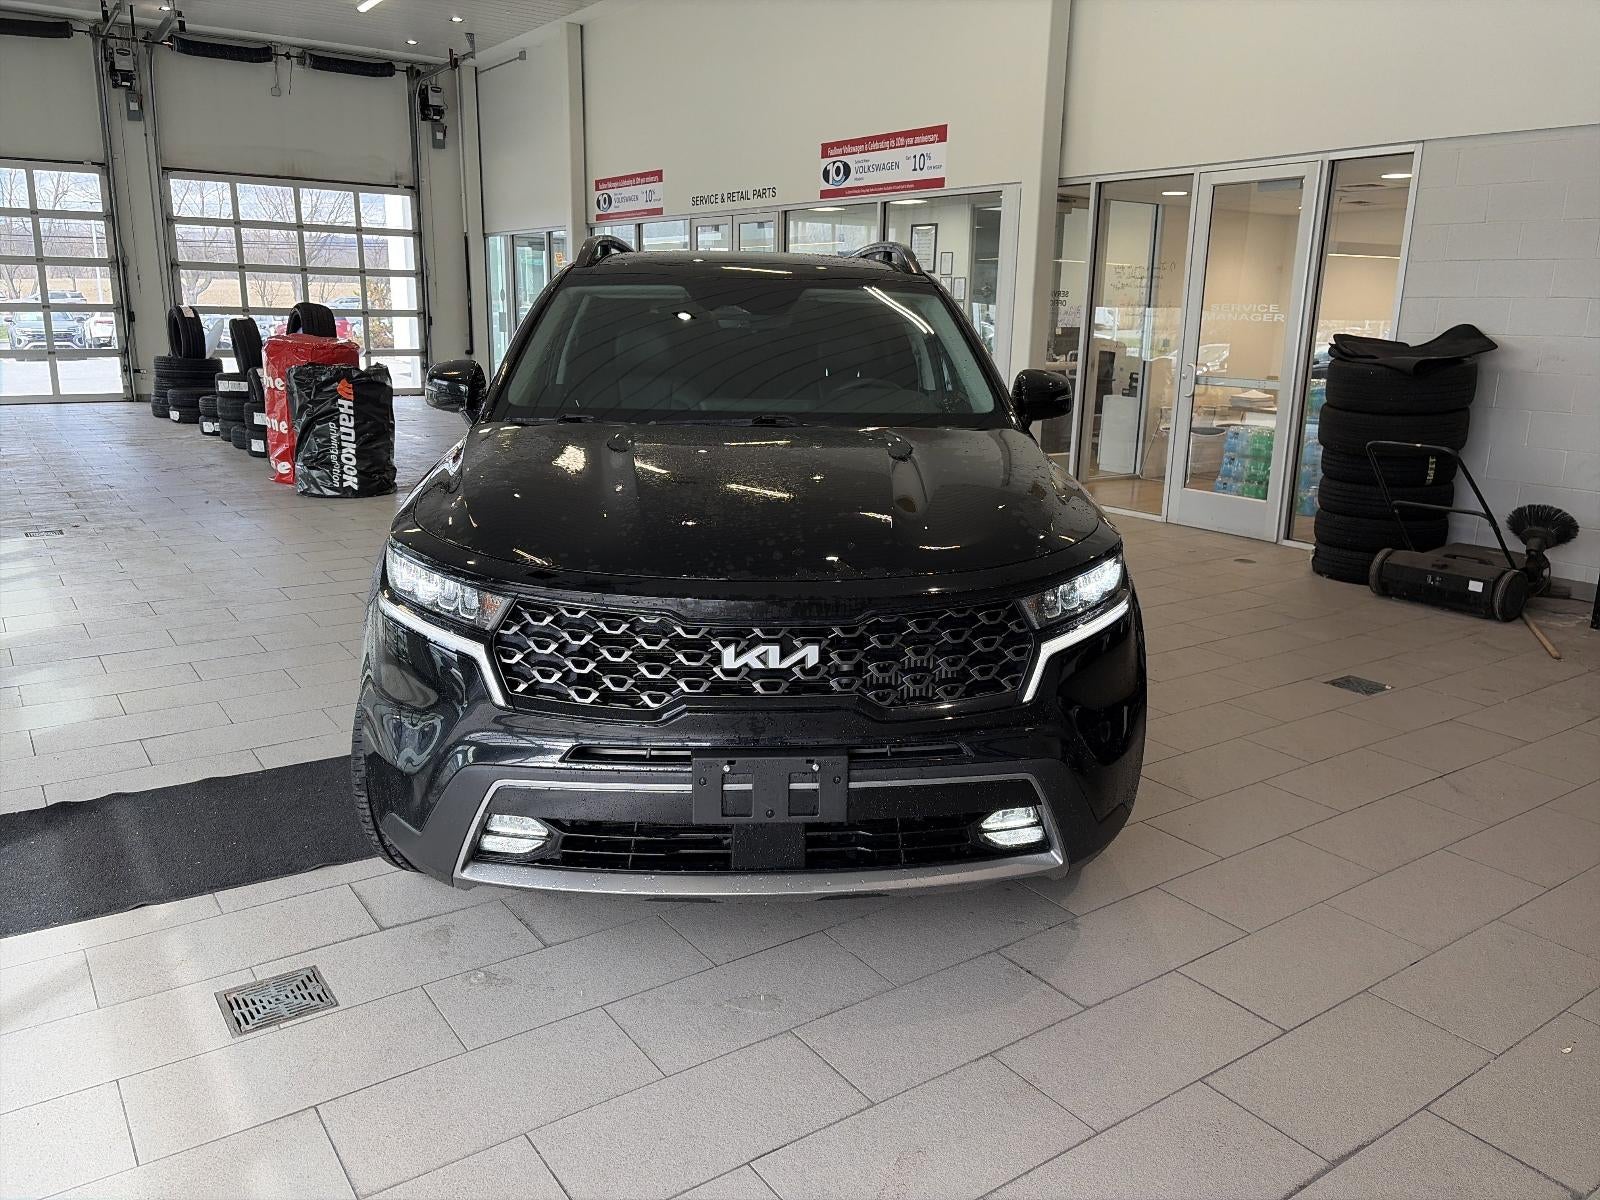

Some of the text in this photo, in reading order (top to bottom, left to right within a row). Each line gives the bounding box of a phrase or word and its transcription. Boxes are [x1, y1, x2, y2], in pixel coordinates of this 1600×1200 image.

[854, 161, 900, 175] VOLKSWAGEN
[691, 187, 777, 206] SERVICE & RETAIL PARTS
[1211, 304, 1279, 312] SERVICE
[1204, 312, 1285, 322] MANAGER
